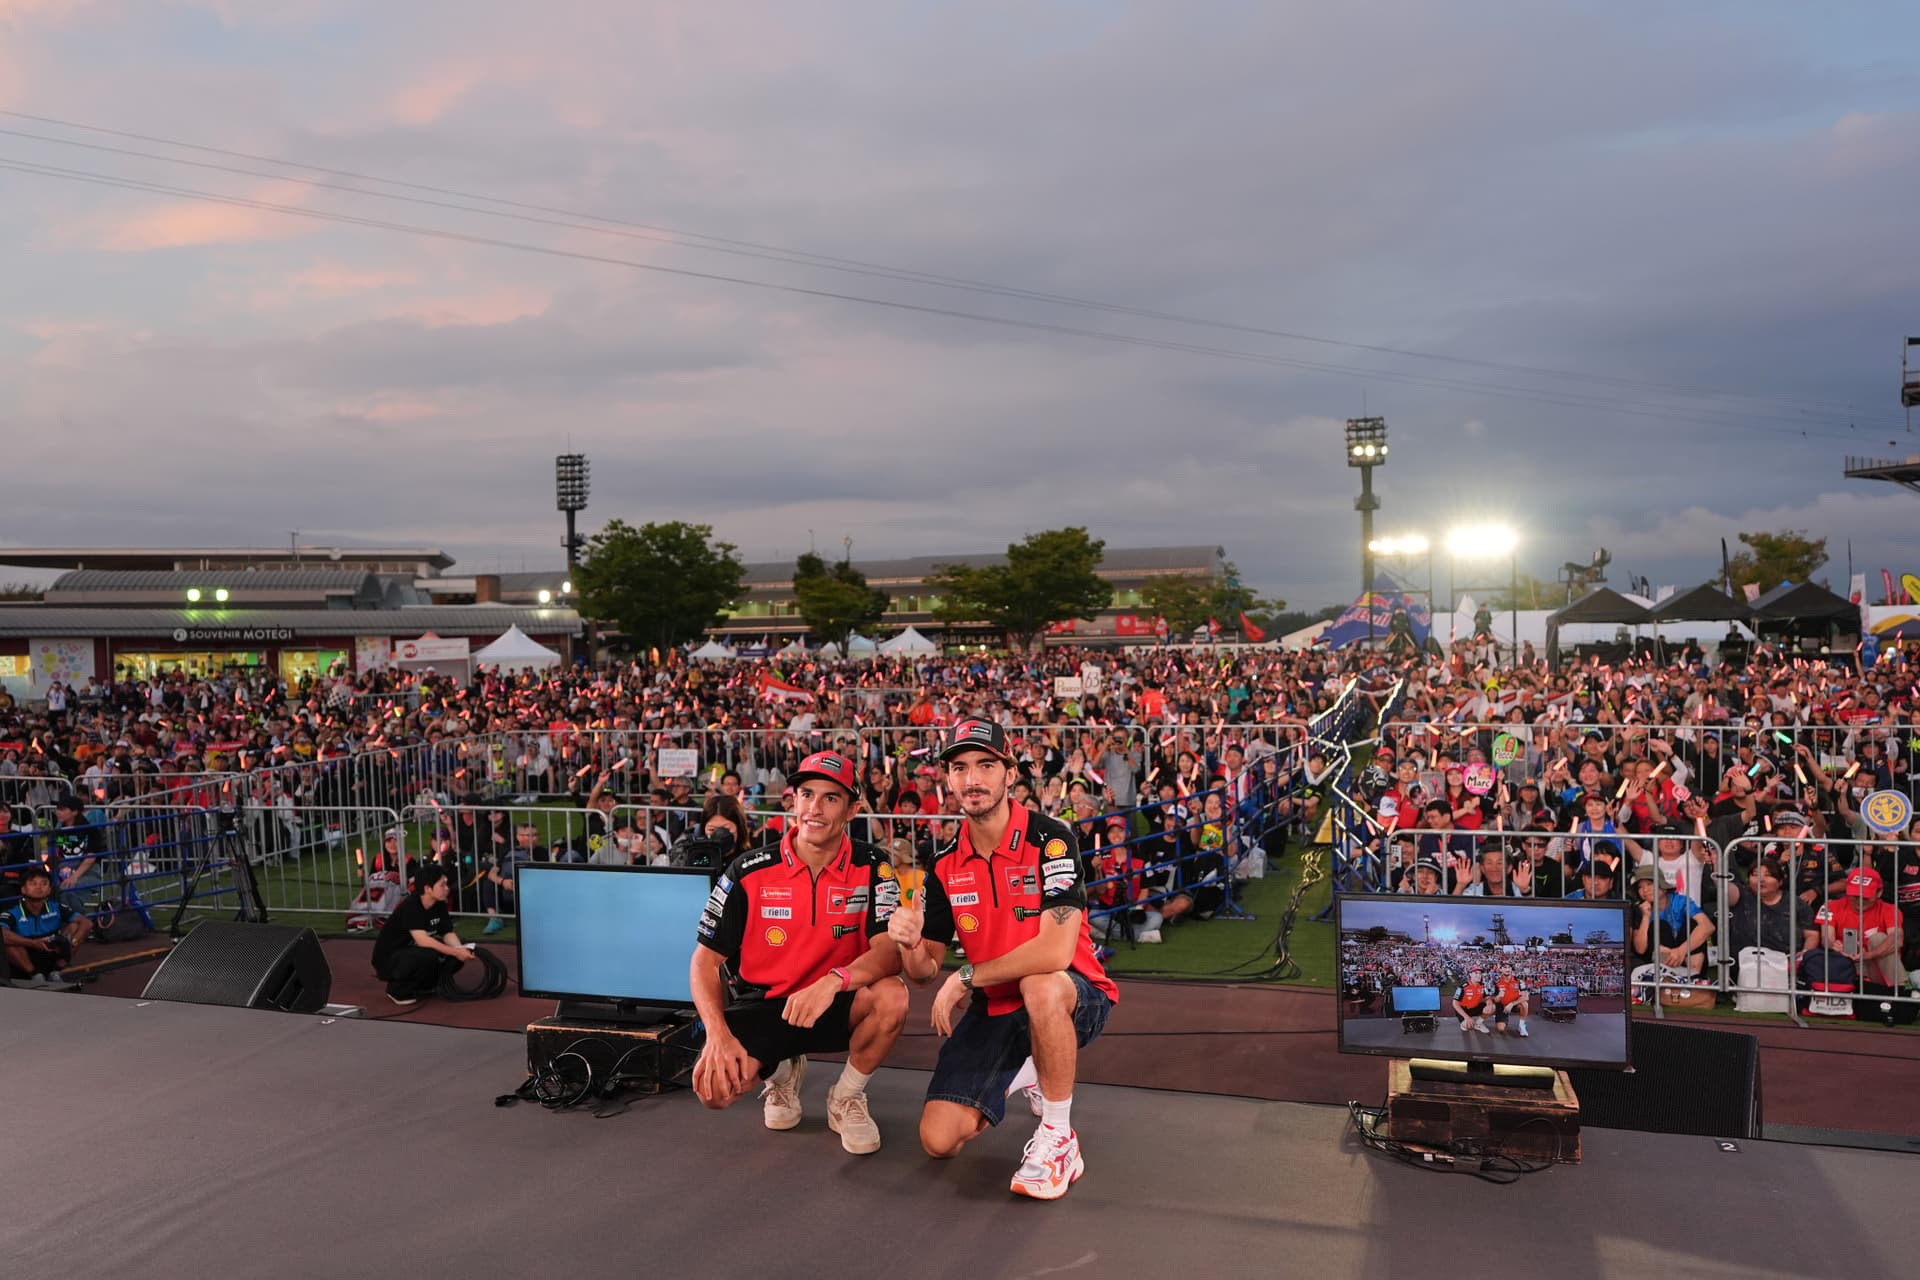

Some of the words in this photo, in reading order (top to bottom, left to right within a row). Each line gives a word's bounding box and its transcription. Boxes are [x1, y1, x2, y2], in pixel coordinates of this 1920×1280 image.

[190, 630, 240, 639] SOUVENIR
[243, 628, 292, 639] MOTEGI
[1467, 776, 1490, 787] Marc
[768, 907, 790, 916] riello
[1721, 1142, 1737, 1151] 2
